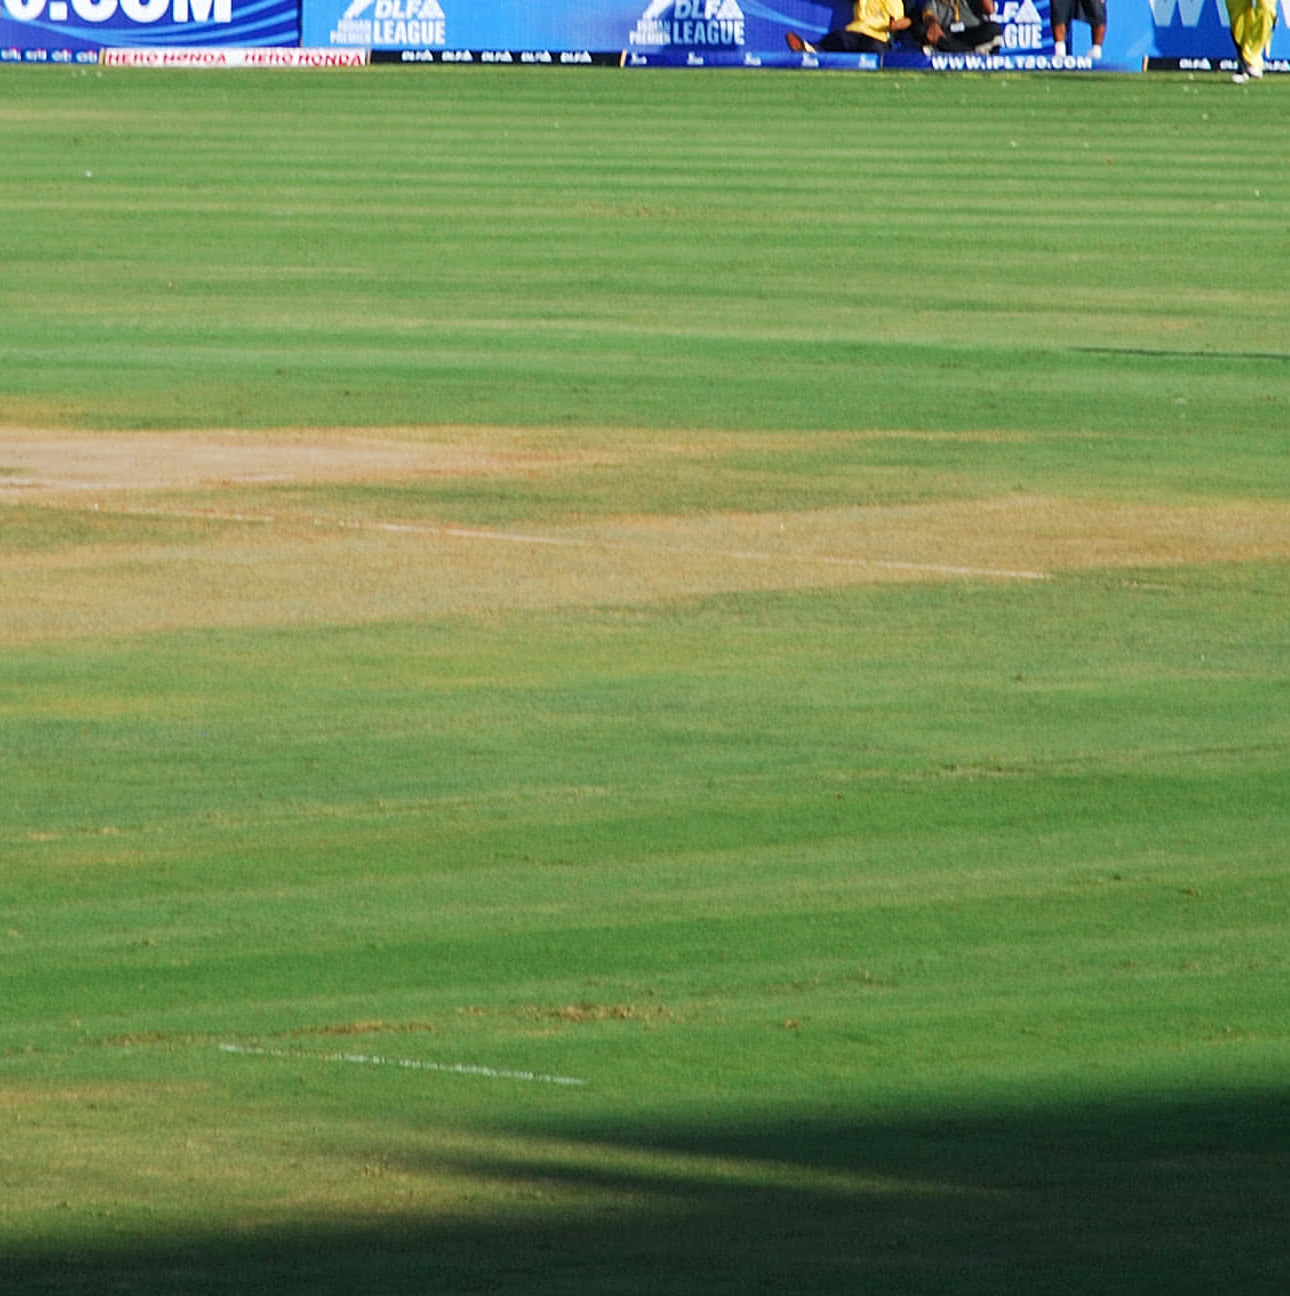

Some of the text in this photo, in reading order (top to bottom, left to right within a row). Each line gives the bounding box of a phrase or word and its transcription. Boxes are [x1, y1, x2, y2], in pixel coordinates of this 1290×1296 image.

[373, 20, 446, 45] LEAGUE
[673, 20, 745, 46] LEAGUE
[108, 54, 364, 66] HERO HONDA HERO HONDA
[931, 55, 1093, 70] WWW.IPLT20.COM
